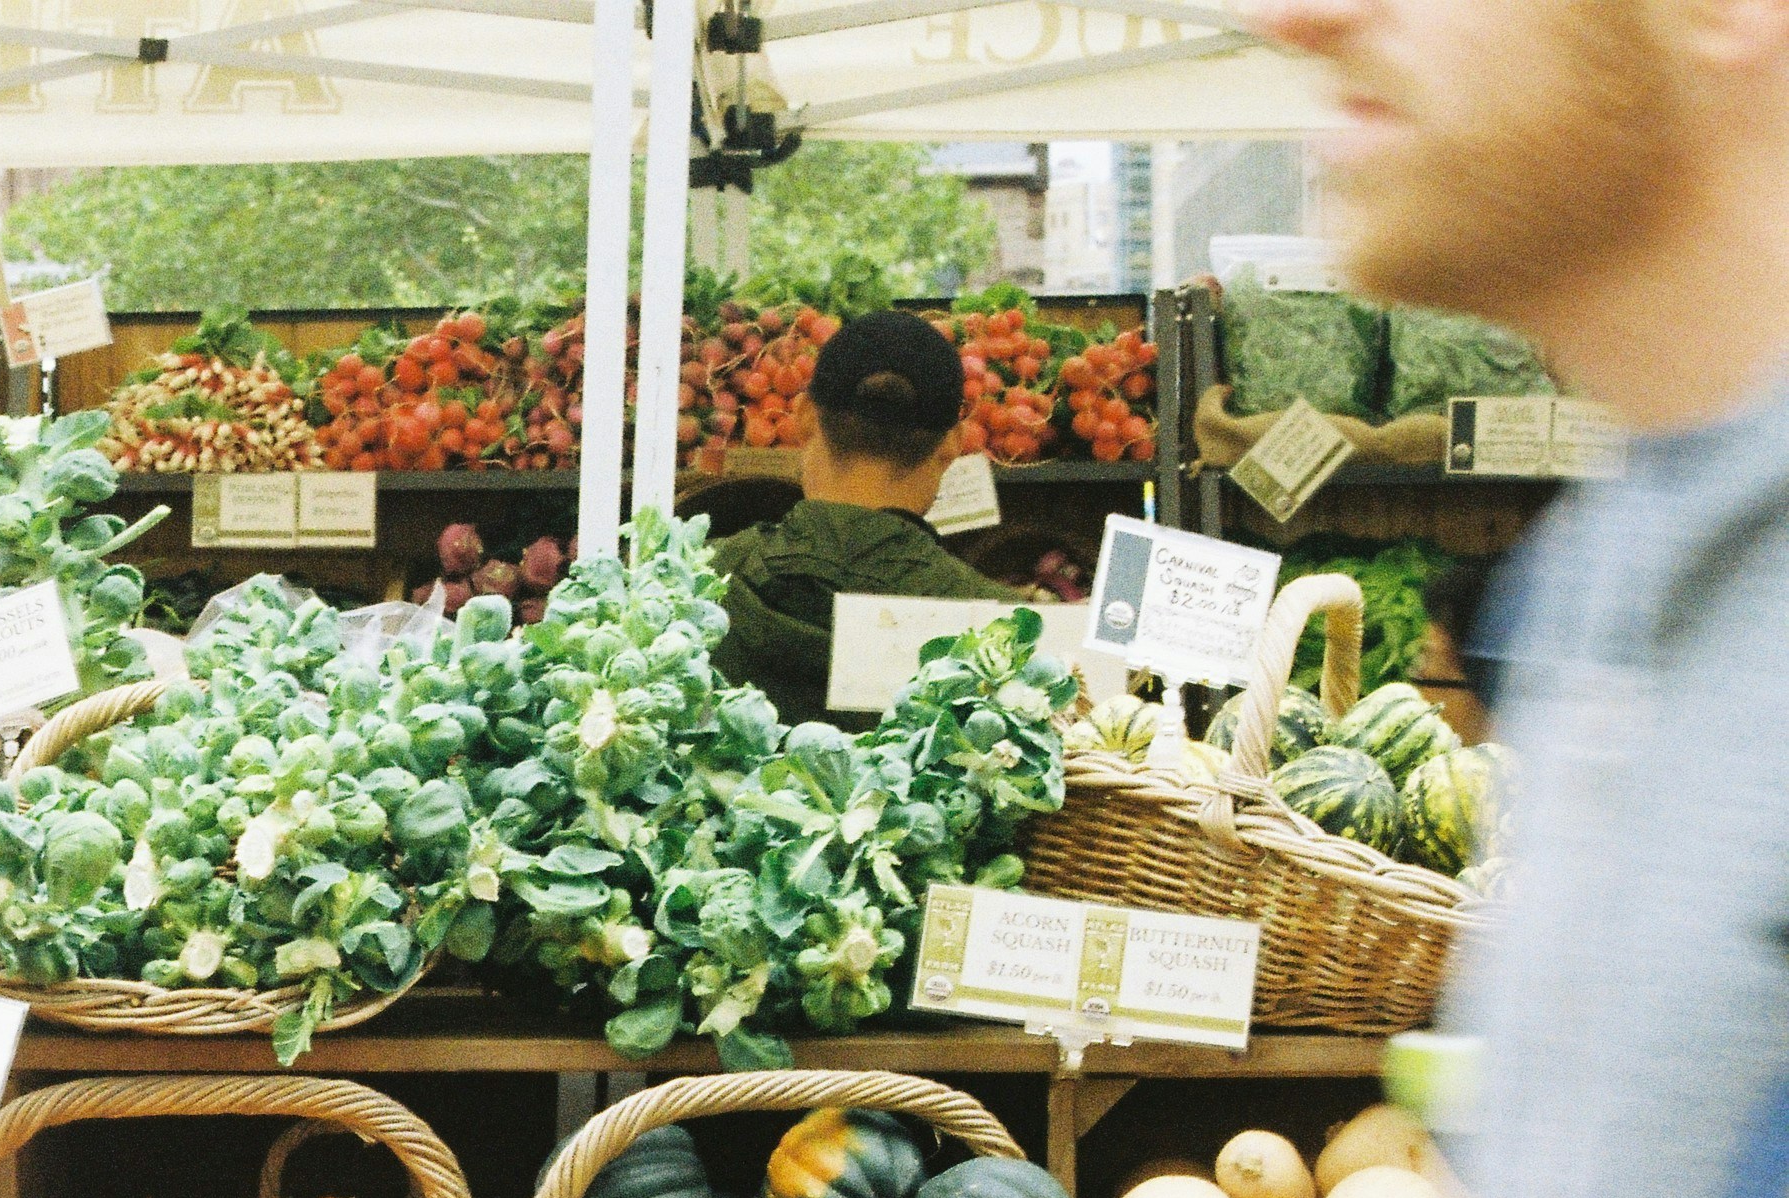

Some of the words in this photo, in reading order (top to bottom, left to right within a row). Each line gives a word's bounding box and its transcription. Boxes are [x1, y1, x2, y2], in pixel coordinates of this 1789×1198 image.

[1155, 547, 1219, 579] CARNIVAL
[1159, 566, 1215, 596] SQUASH
[999, 911, 1071, 933] ACORN
[990, 929, 1072, 954] SQUASH
[1129, 927, 1254, 954] BUTTERNUT
[986, 960, 1032, 979] $1.50
[1147, 949, 1228, 972] SQUASH
[1143, 980, 1190, 999] $1.50
